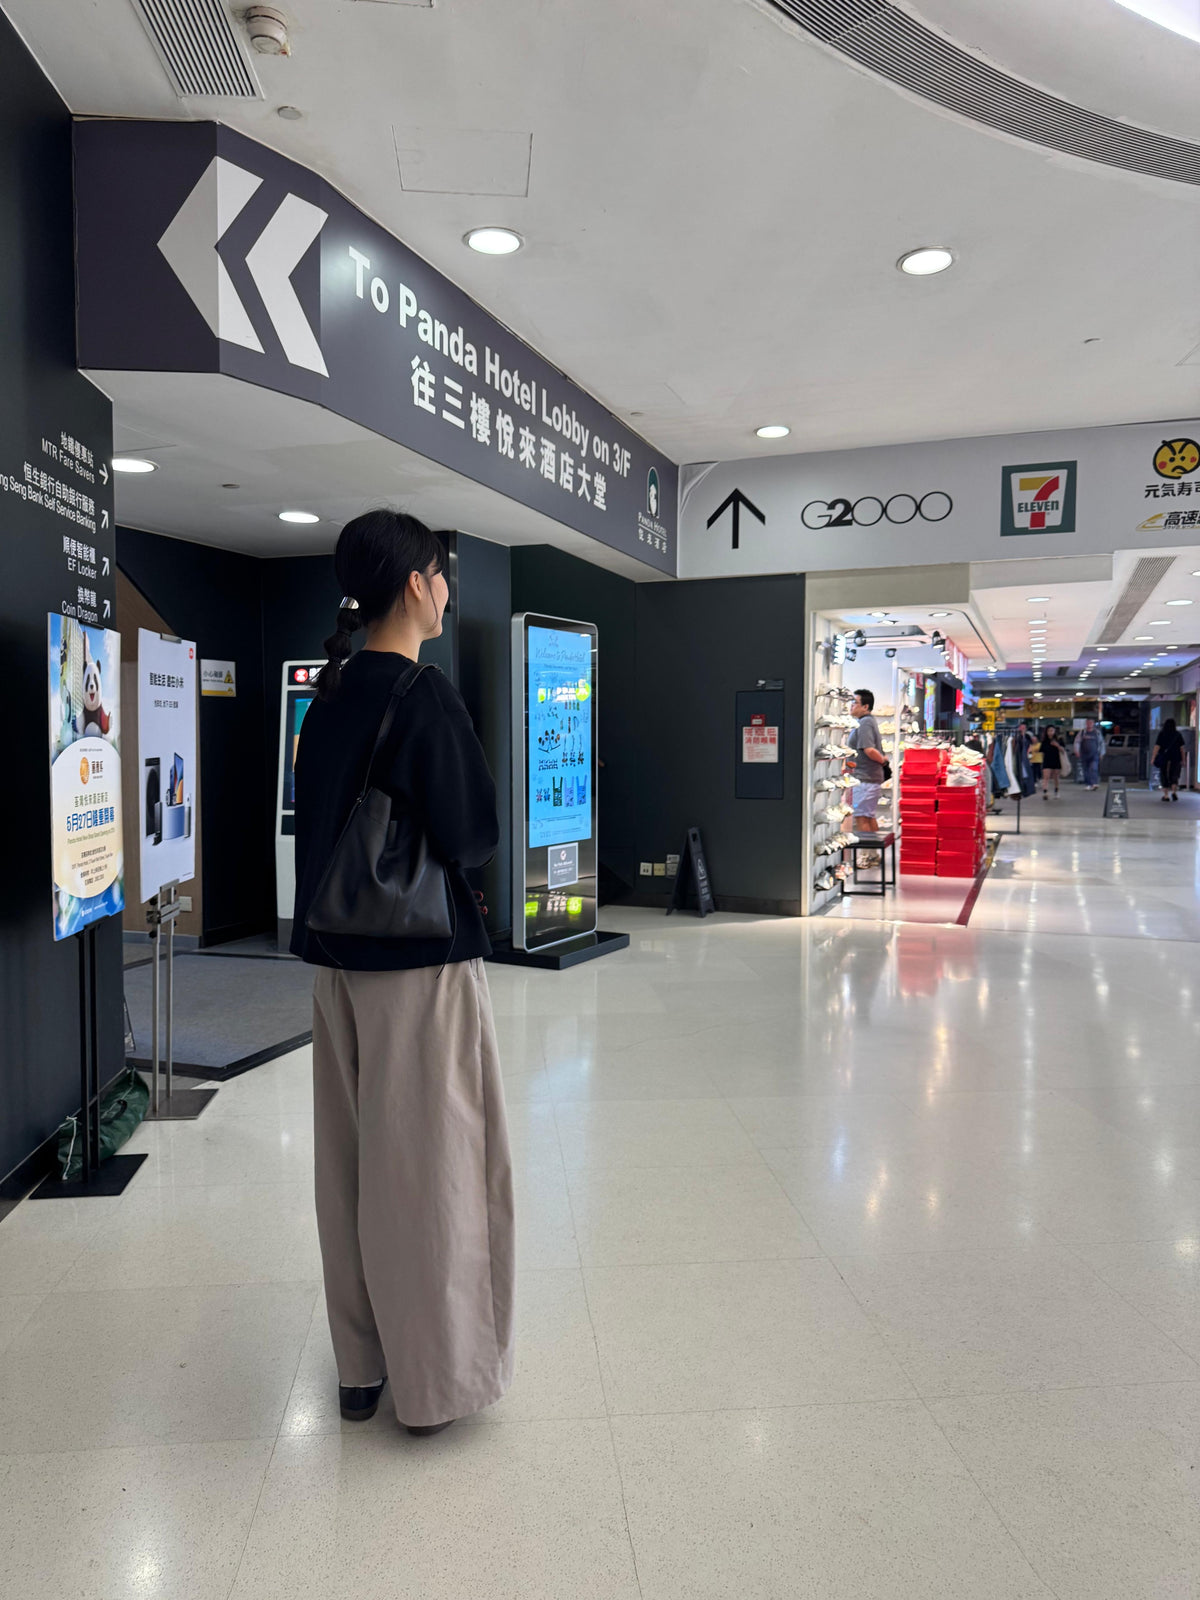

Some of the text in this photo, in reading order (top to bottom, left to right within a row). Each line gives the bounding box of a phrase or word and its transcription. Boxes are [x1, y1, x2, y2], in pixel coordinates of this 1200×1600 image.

[349, 245, 631, 478] To Panda Hotel Lobby on 3/F
[41, 437, 95, 484] MTR Fare Savers
[9, 475, 27, 500] Seng
[28, 485, 44, 506] Bank
[44, 494, 56, 511] Self
[56, 500, 76, 521] Service
[77, 510, 96, 534] Banking
[801, 491, 953, 530] G2000
[1019, 475, 1060, 529] 7
[1164, 510, 1200, 527] 高速
[67, 557, 97, 580] EF Locker
[61, 600, 98, 624] Coin Dragon
